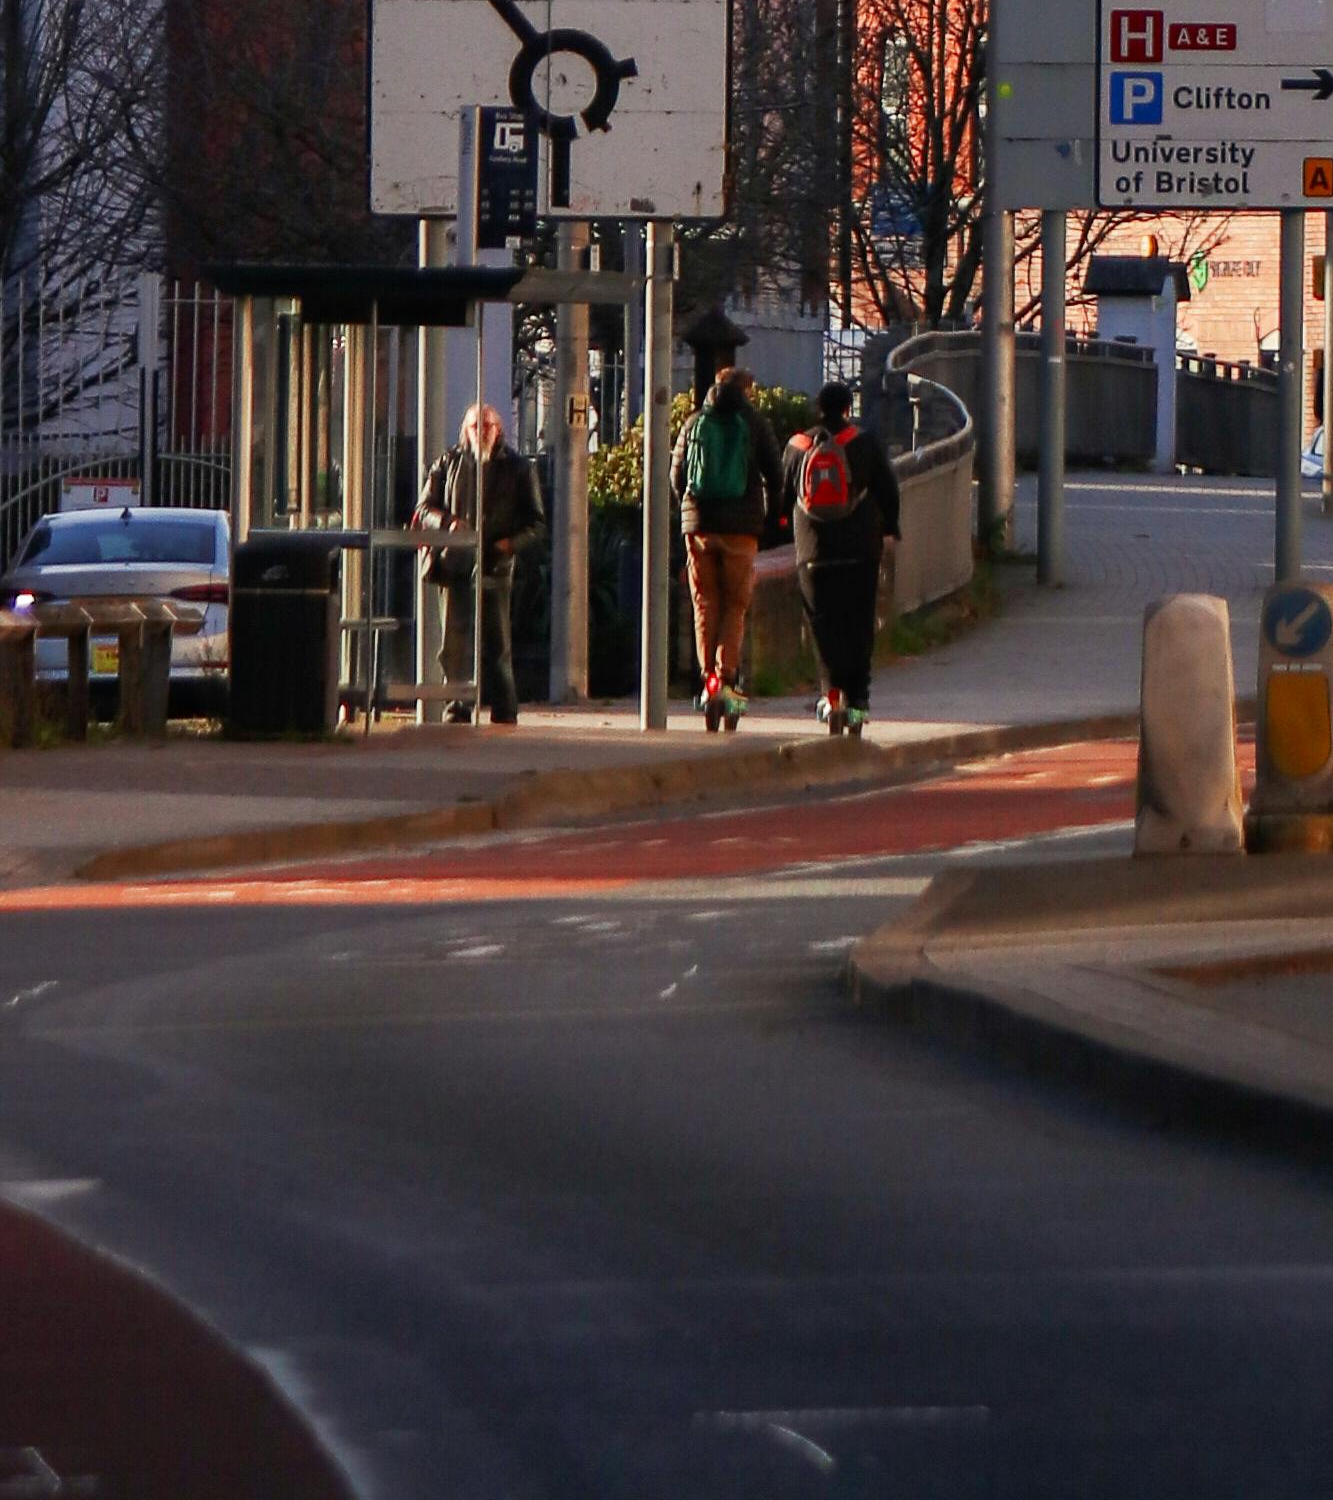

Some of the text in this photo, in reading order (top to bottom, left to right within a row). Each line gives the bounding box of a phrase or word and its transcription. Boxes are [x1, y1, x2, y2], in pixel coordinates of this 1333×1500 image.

[1120, 16, 1154, 57] H
[1123, 78, 1155, 119] P
[1173, 86, 1270, 109] Clifton
[1111, 140, 1255, 168] University
[1115, 171, 1249, 194] of Bristol
[1309, 167, 1329, 189] A
